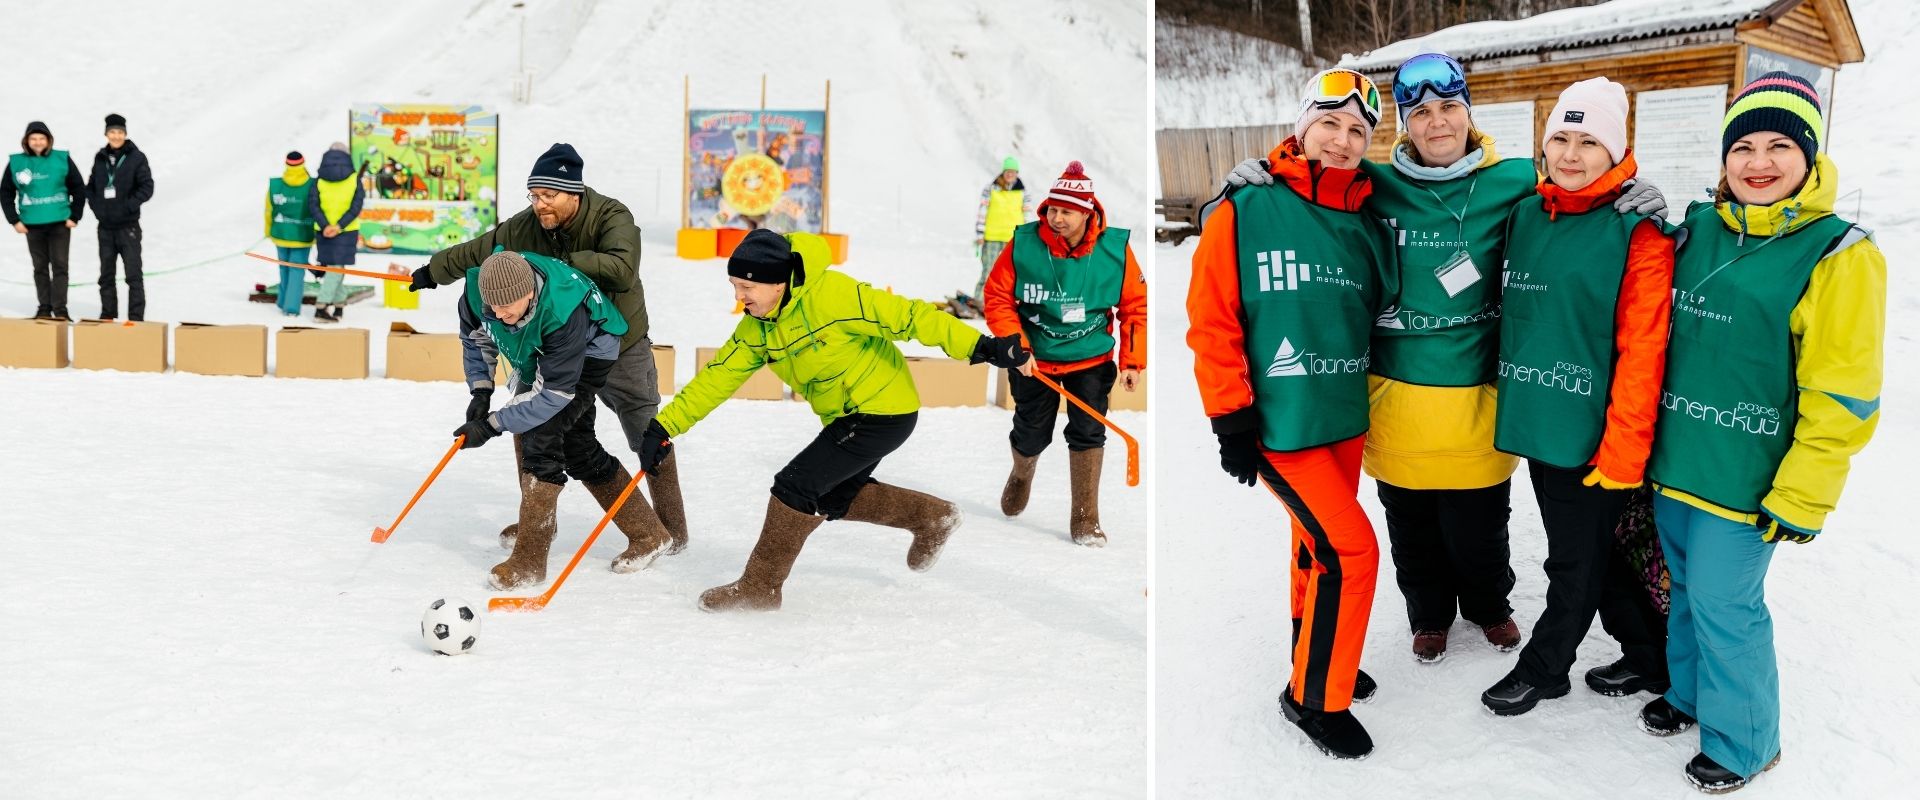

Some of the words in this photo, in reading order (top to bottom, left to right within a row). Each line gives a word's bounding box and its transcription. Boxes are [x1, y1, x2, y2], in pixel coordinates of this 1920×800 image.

[1055, 180, 1085, 191] FILA
[1411, 230, 1440, 239] TLP
[1410, 240, 1469, 249] management
[1314, 264, 1343, 276] TLP
[1511, 271, 1530, 281] TLP
[1681, 290, 1706, 305] TLP
[1737, 401, 1780, 420] разрез
